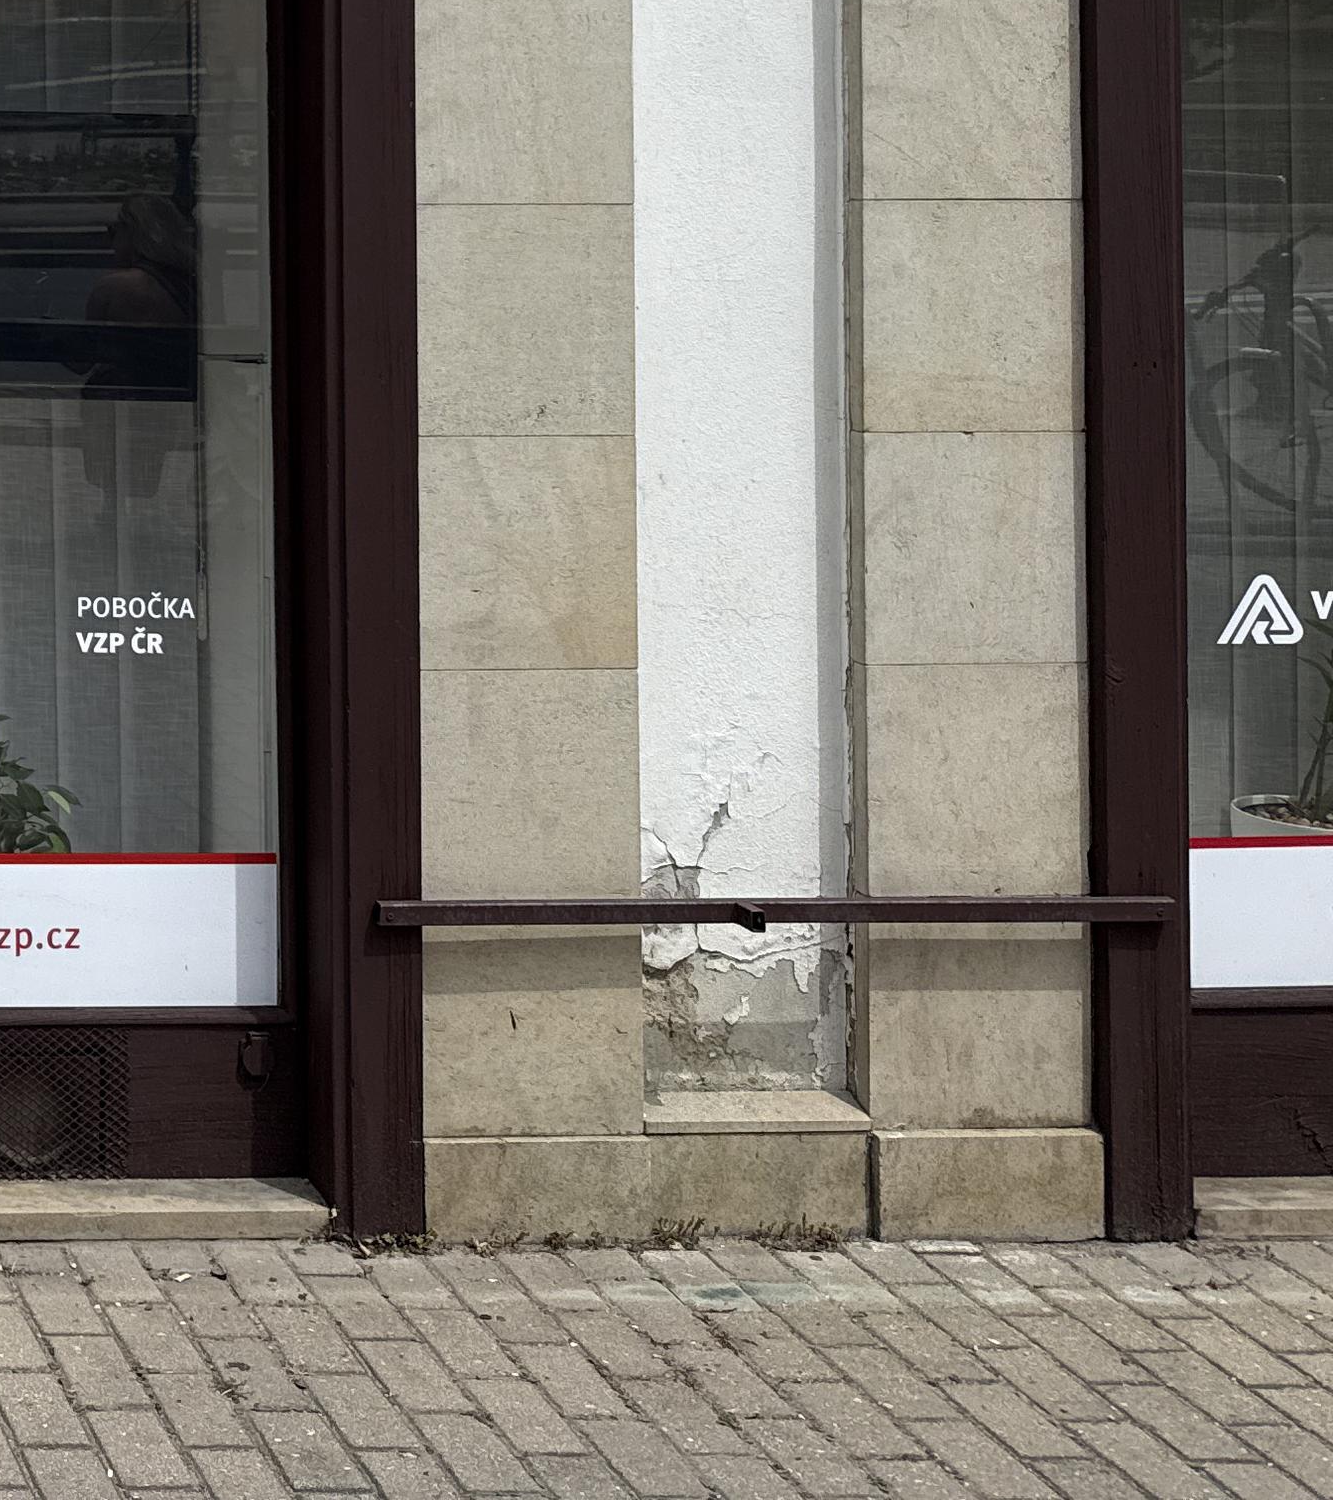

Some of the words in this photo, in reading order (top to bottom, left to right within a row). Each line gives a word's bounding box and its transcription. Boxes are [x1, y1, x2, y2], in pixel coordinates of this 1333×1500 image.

[77, 591, 195, 619] POBOČKA
[76, 632, 125, 654] VZP
[130, 627, 164, 654] ČR
